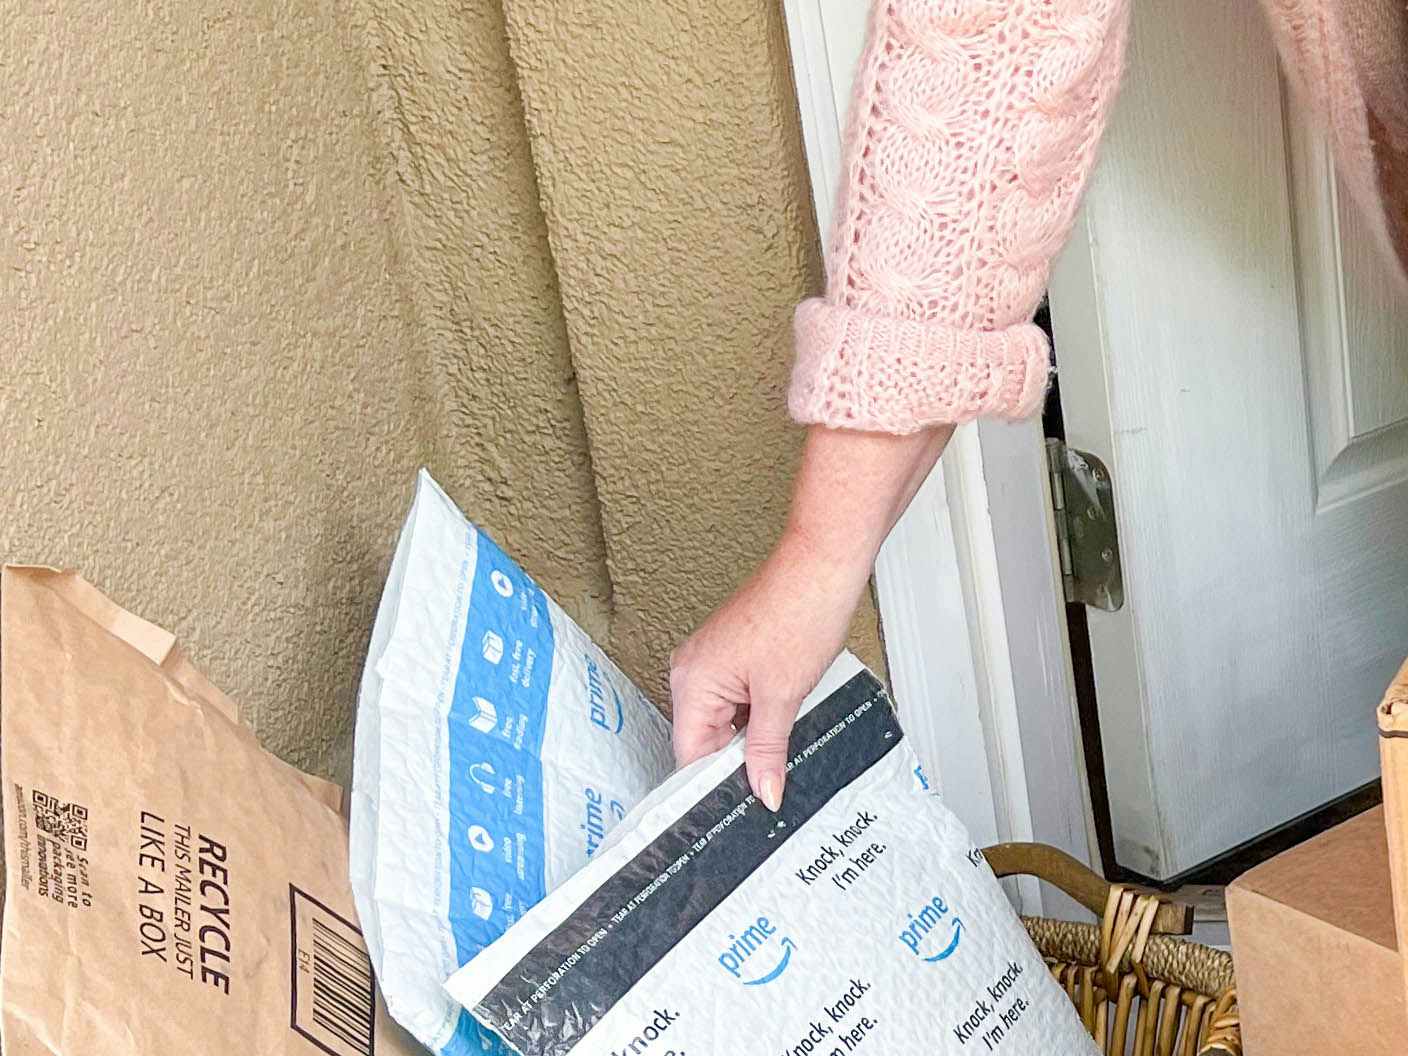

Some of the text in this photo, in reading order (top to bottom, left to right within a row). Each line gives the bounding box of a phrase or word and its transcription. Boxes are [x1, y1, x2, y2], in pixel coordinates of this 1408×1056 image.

[584, 653, 611, 732] prime
[844, 713, 856, 724] TO
[47, 838, 64, 904] packaging
[64, 847, 79, 908] see more
[795, 811, 878, 886] Knock, knock.
[831, 843, 887, 891] I'm here.
[77, 854, 93, 907] Scan to
[138, 810, 167, 963] LIKE A BOX
[174, 824, 194, 980] THIS MAILER JUST
[199, 833, 231, 996] RECYCLE
[610, 907, 629, 924] TEAR
[898, 895, 949, 956] prime
[521, 999, 533, 1015] AT
[530, 952, 581, 1003] PERFORATION
[577, 944, 590, 956] TO
[586, 927, 608, 947] OPEN
[718, 915, 777, 978] prime
[823, 978, 871, 1024] knock.
[952, 960, 1024, 1045] Knock, knock.
[981, 996, 1029, 1052] I'm here.
[838, 1015, 878, 1051] here.
